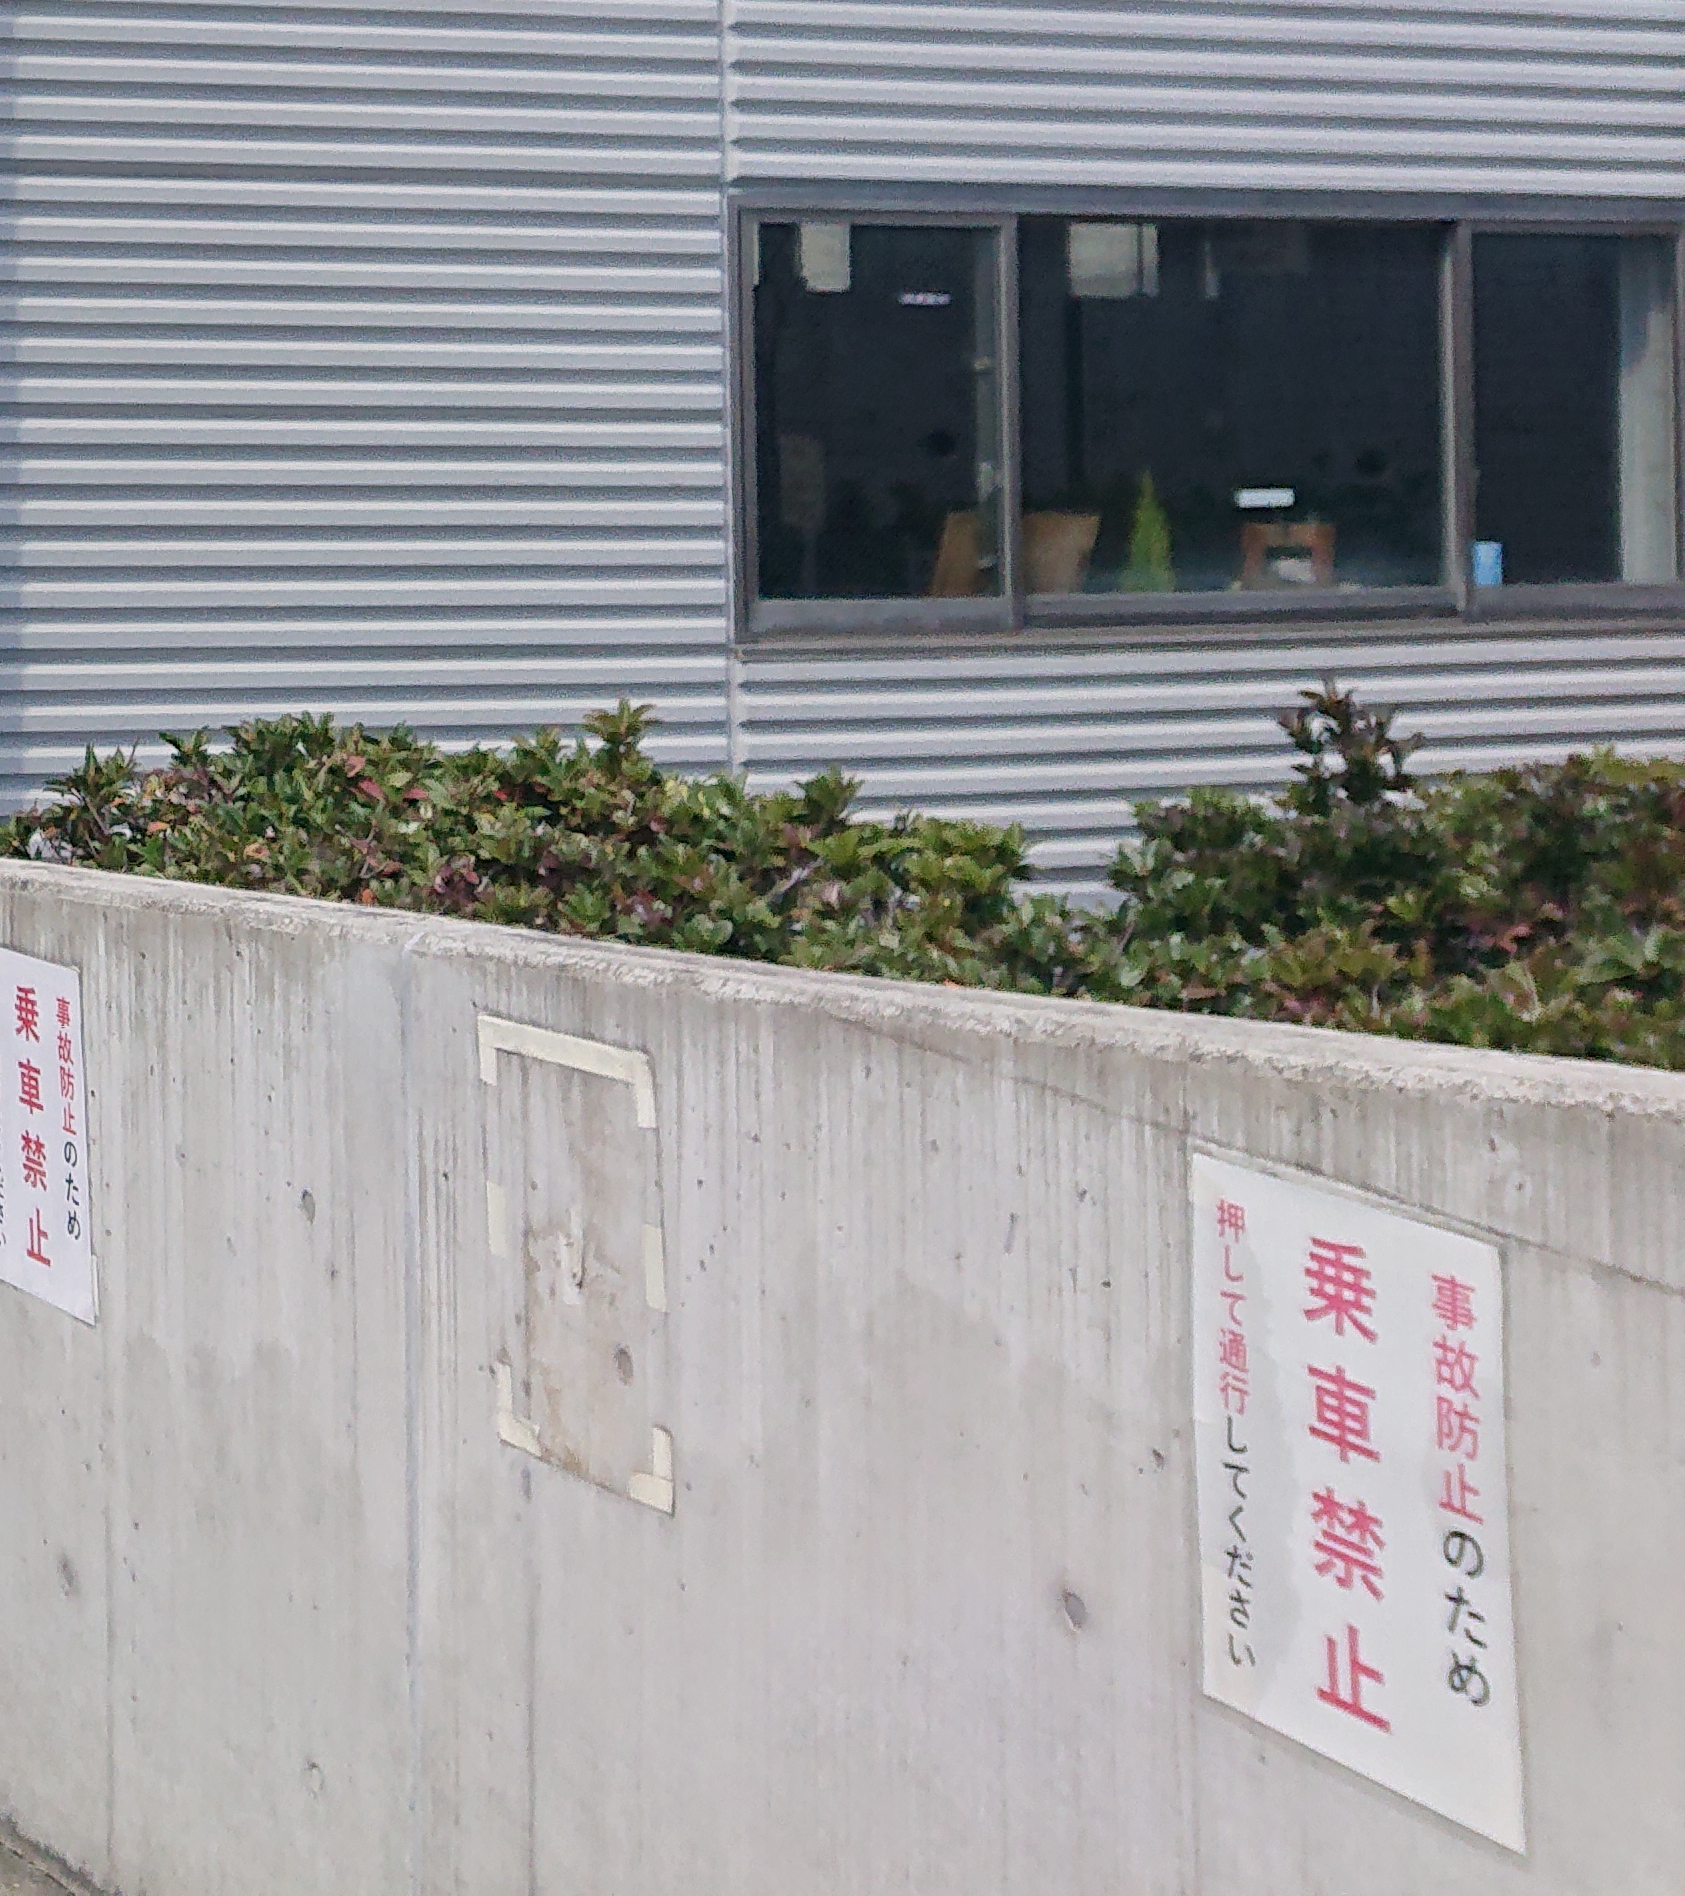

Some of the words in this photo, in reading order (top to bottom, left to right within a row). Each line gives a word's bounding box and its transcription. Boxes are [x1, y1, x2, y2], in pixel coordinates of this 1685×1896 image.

[14, 985, 51, 1268] 乗車禁止
[55, 996, 81, 1241] 事故防止のため
[1215, 1198, 1257, 1669] 押して通行してください
[1303, 1236, 1392, 1733] 乗車禁止
[1430, 1272, 1491, 1707] 事故防止のため
